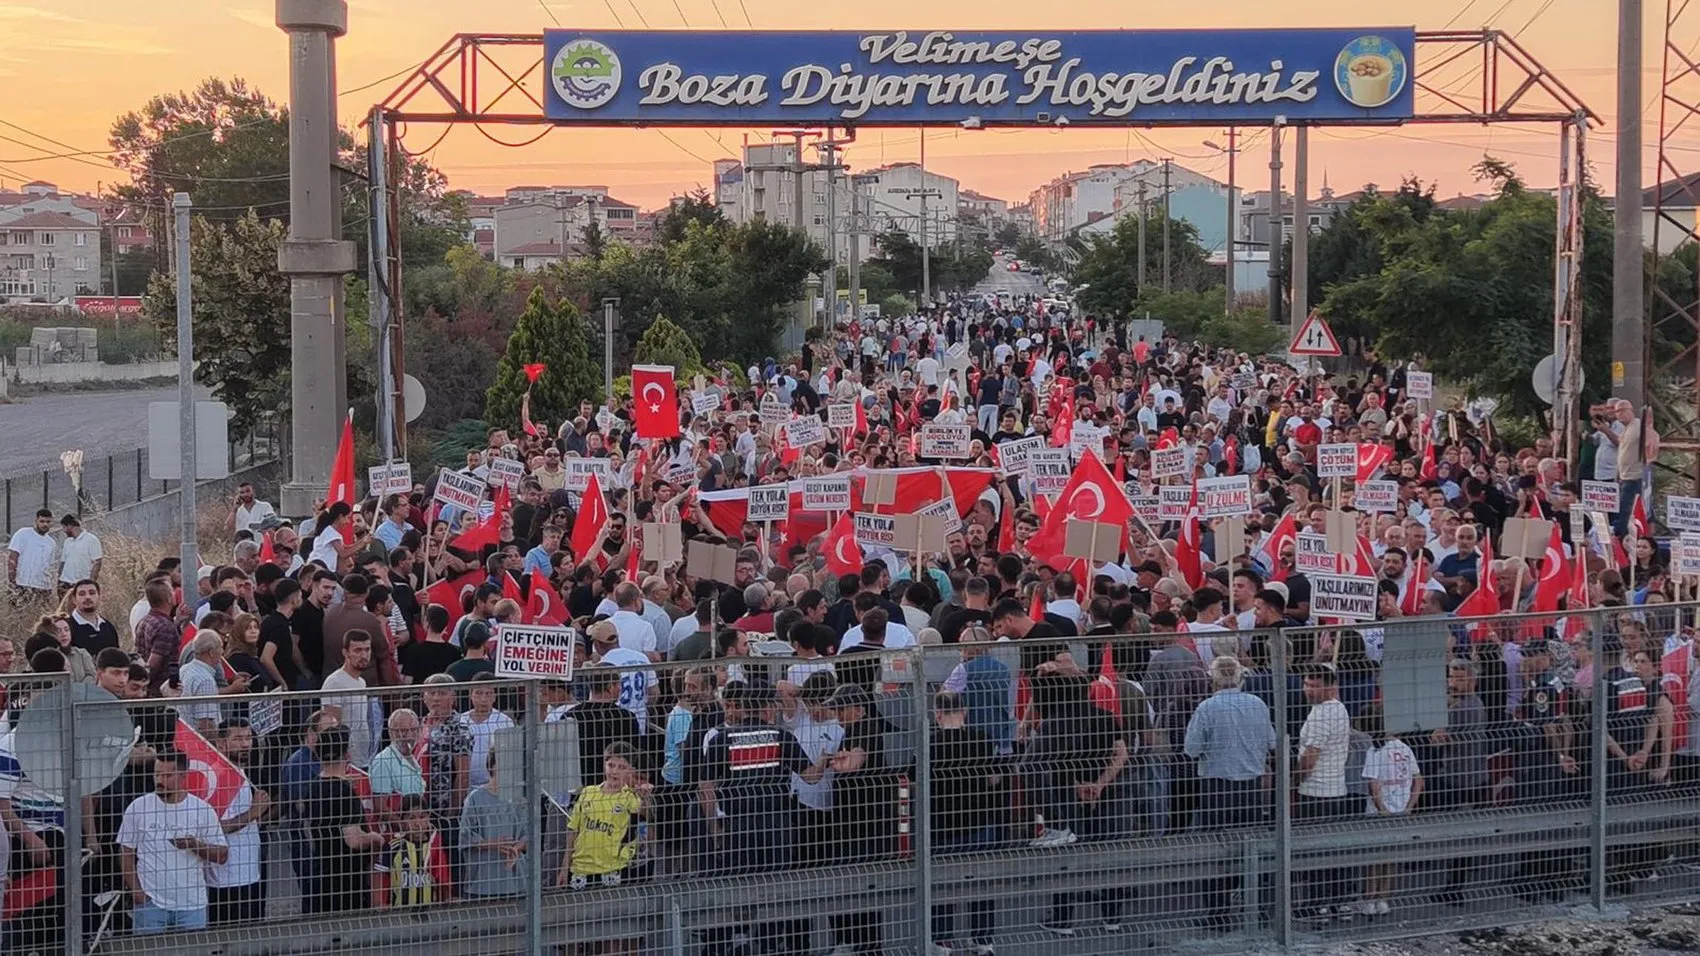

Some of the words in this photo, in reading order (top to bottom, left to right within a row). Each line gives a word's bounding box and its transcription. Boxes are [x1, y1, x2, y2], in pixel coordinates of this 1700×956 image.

[859, 31, 1062, 70] Velimeşe
[638, 62, 769, 106] Boza
[780, 62, 1010, 119] Diyarına
[1015, 57, 1320, 117] Hoşgeldiniz
[752, 490, 763, 502] TEK
[766, 490, 786, 502] YOLA
[750, 503, 770, 515] BÜYÜK
[857, 516, 871, 527] TEK
[873, 518, 895, 531] YOLA
[1317, 579, 1374, 597] YAŞLILARIMIZI
[504, 631, 570, 647] ÇİFTÇİNİN
[503, 644, 568, 663] EMEĞİNE
[503, 660, 525, 672] YOL
[528, 661, 567, 675] VERİN!
[620, 671, 645, 705] 59
